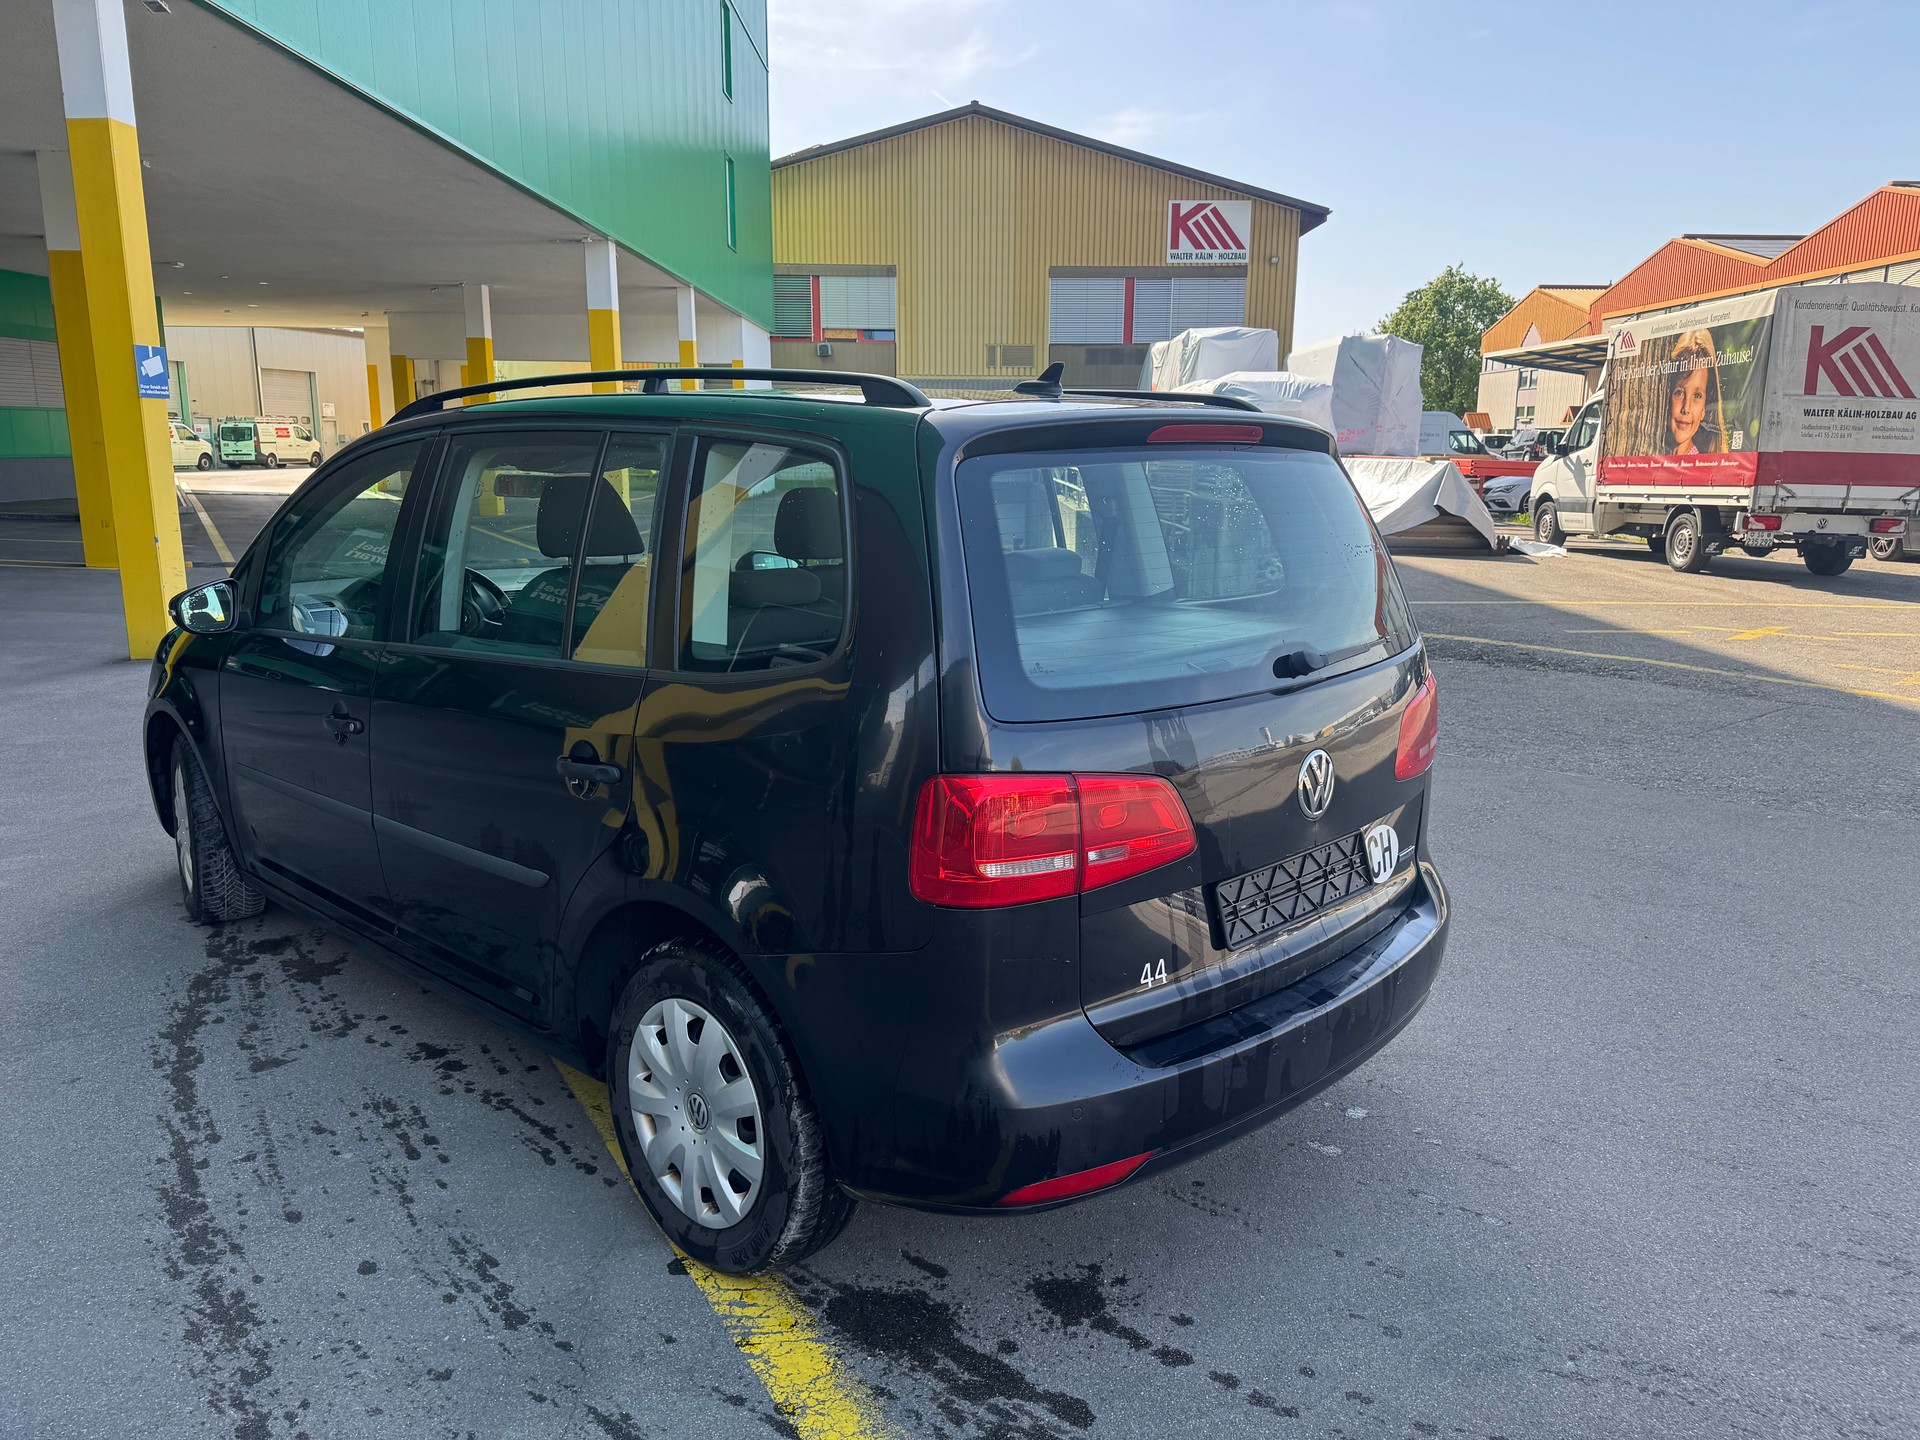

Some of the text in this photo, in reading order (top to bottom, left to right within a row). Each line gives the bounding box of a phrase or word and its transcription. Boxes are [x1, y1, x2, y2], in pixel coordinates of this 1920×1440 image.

[1170, 252, 1193, 260] WALTER
[1195, 251, 1213, 260] KÄLIN
[1218, 252, 1247, 260] HOLZBAU
[1617, 345, 1754, 381] Die Kraft der Natur in Ihrem Zuhause!
[1803, 407, 1917, 420] WALTER KÄLIN-HOLZBAU AG
[1746, 537, 1759, 546] 235
[1367, 828, 1393, 879] CH
[1139, 958, 1168, 989] 44
